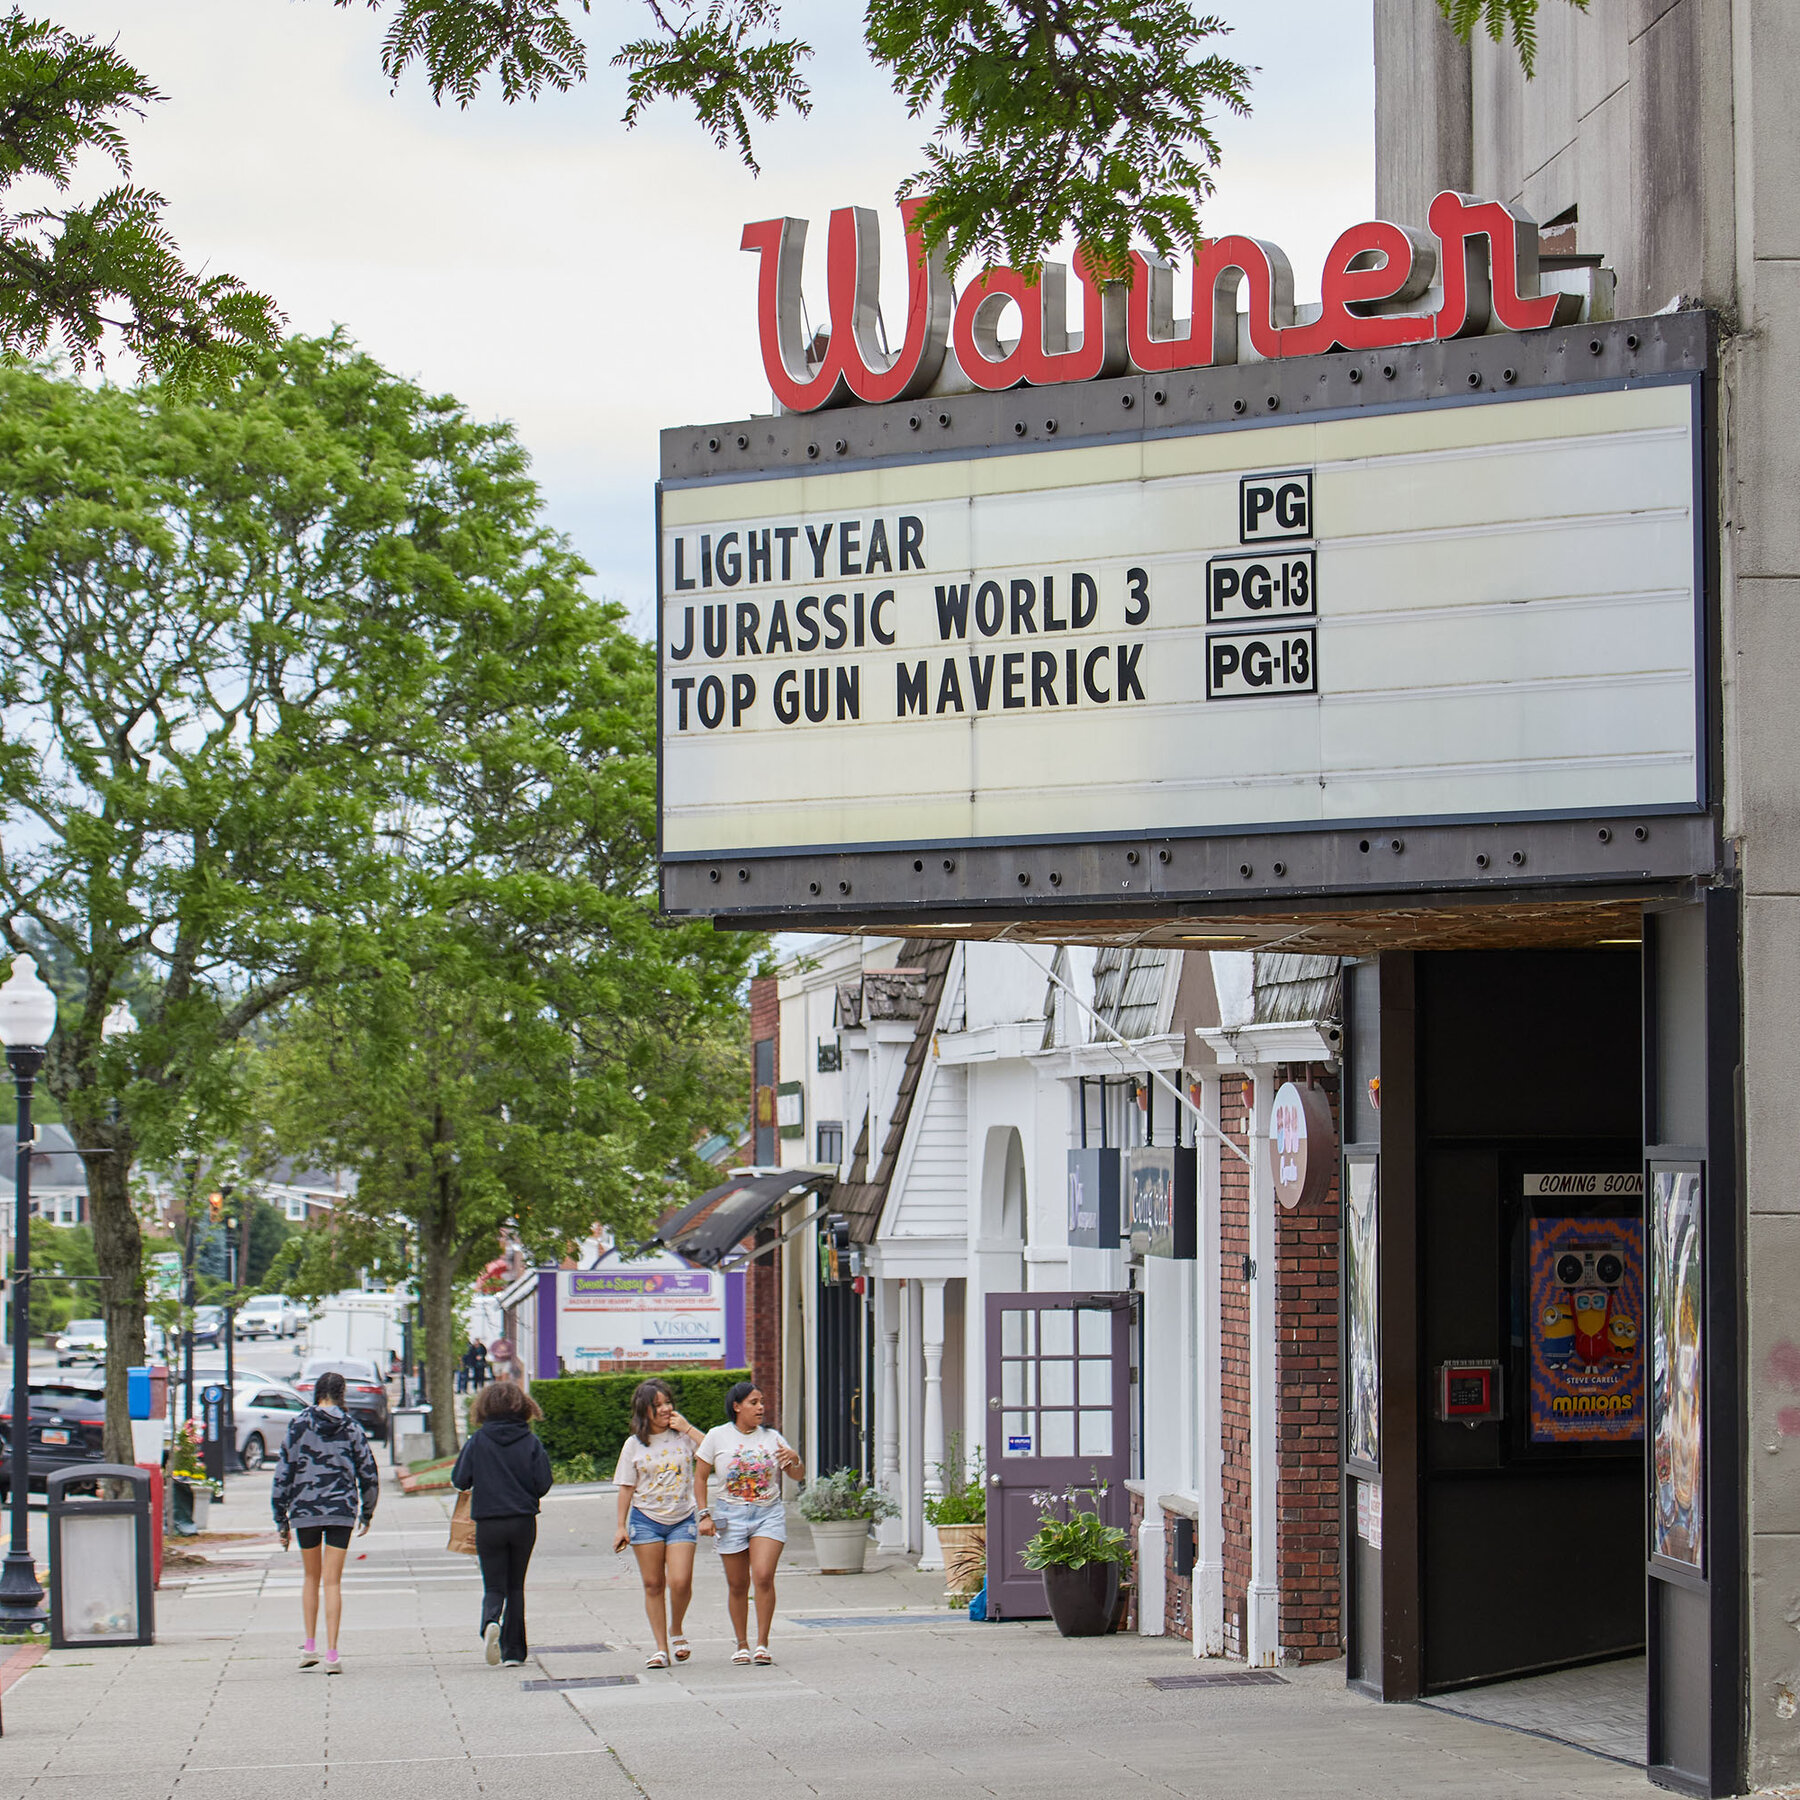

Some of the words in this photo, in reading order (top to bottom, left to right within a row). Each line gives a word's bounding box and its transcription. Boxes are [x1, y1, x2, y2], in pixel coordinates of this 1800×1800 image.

[740, 191, 1584, 413] Warner
[675, 516, 926, 591] LIGHTYEAR
[1246, 482, 1307, 532] PG
[671, 589, 896, 661] JURASSIC
[934, 572, 1098, 641] WORLD
[1124, 567, 1150, 626] 3
[1213, 560, 1309, 613] PG-13
[671, 673, 757, 731] TOP
[774, 665, 860, 725] GUN
[896, 643, 1146, 718] MAVERICK
[1212, 637, 1310, 689] PG-13
[1539, 1175, 1596, 1193] COMING
[1604, 1174, 1643, 1192] SOON
[1566, 1376, 1589, 1385] STEVE
[1591, 1376, 1619, 1384] CARELL
